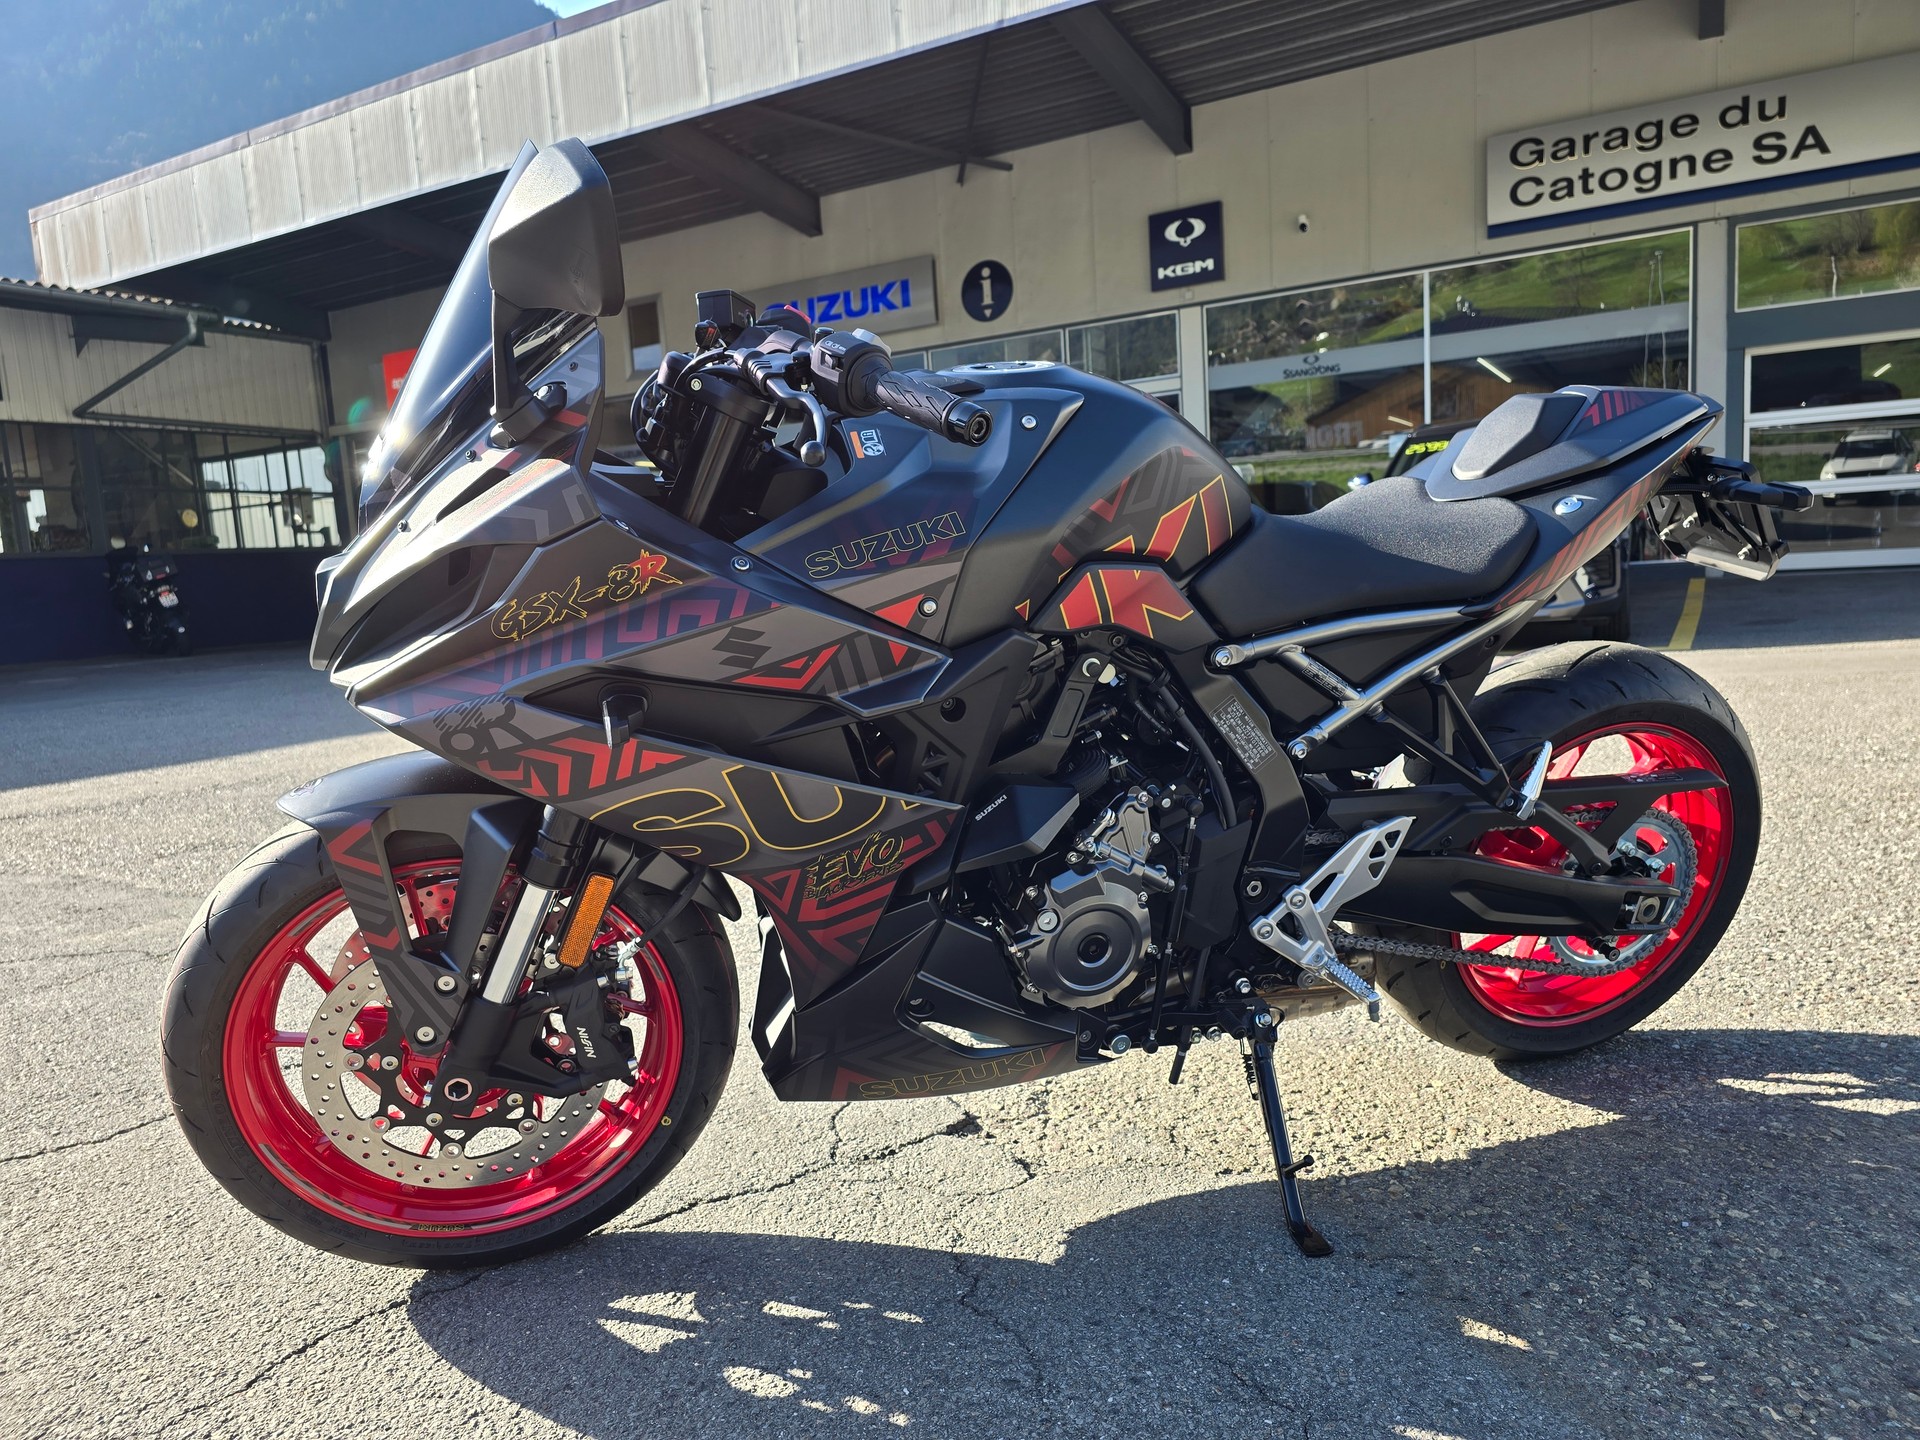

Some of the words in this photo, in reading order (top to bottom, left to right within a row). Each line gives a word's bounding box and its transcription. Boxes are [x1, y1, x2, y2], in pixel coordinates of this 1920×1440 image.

[1509, 113, 1700, 170] Garage
[1718, 95, 1788, 130] du
[1508, 148, 1734, 207] Catogne
[1751, 124, 1832, 165] SA
[1157, 258, 1215, 280] KGM
[766, 279, 912, 325] UZUKI
[805, 511, 966, 579] SUZUKI
[491, 549, 684, 642] GSX-8R
[974, 794, 1008, 821] SUZUKI
[806, 831, 904, 890] EVO
[859, 1048, 1047, 1100] SUZUKI
